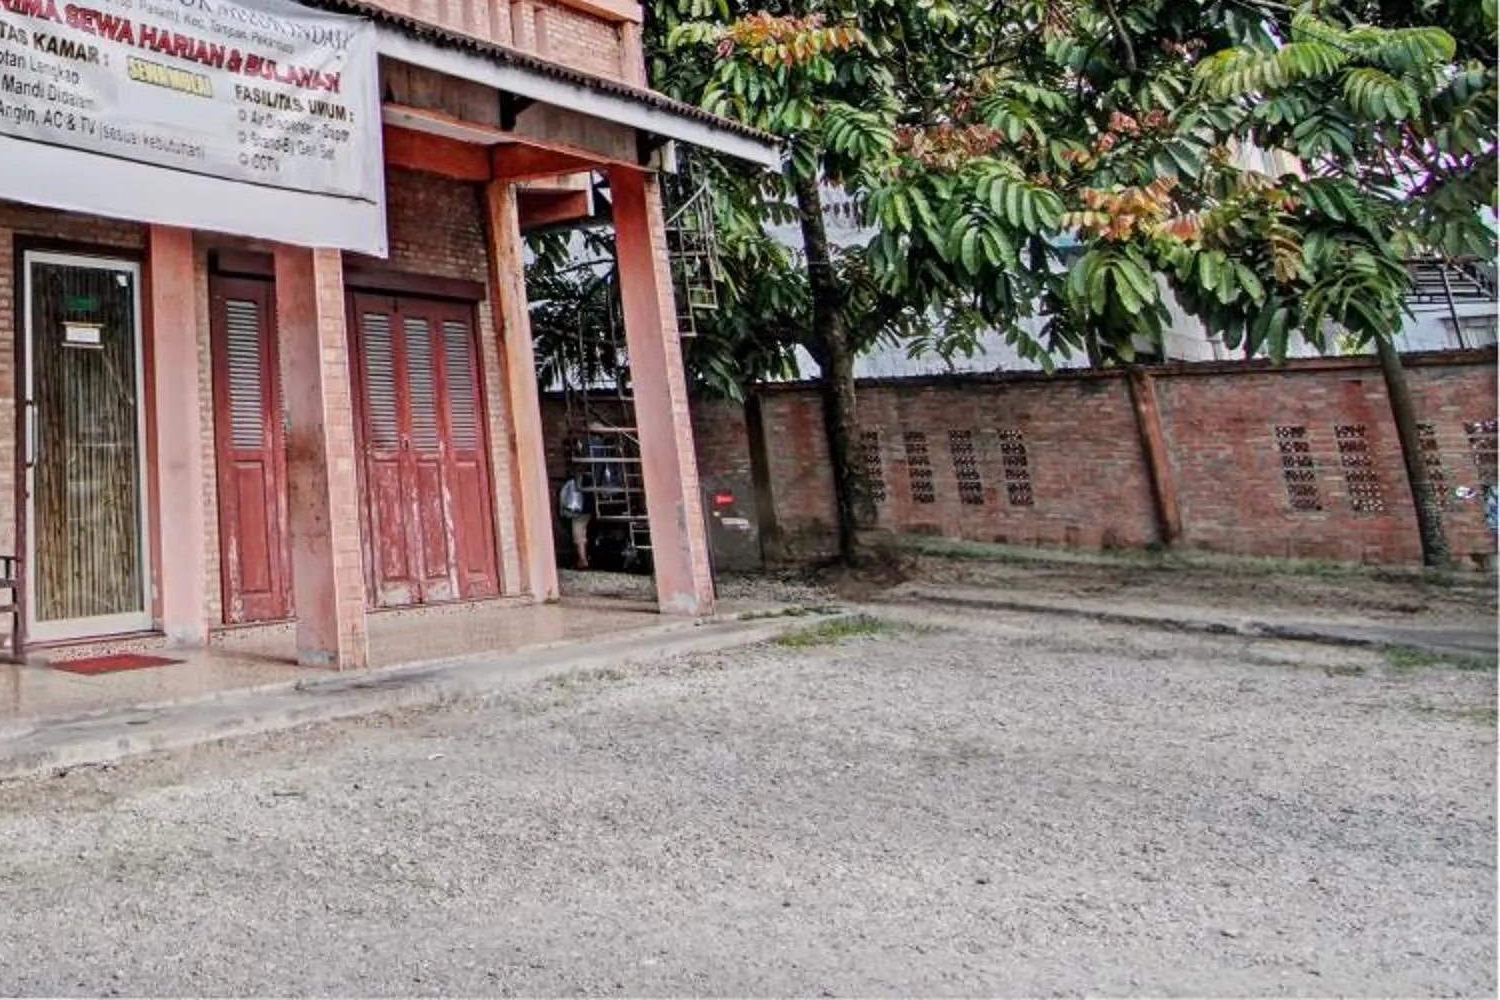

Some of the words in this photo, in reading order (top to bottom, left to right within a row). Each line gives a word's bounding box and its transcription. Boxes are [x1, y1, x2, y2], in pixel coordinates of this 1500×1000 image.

[33, 31, 99, 64] KAMAR
[64, 3, 135, 46] SEWA
[138, 22, 226, 69] HARIAN
[227, 49, 244, 74] &
[2, 74, 45, 99] Mandi
[235, 84, 304, 112] FASILITAS
[308, 100, 347, 121] UMUM
[43, 111, 63, 129] AC
[65, 114, 77, 131] &
[80, 117, 96, 136] TV
